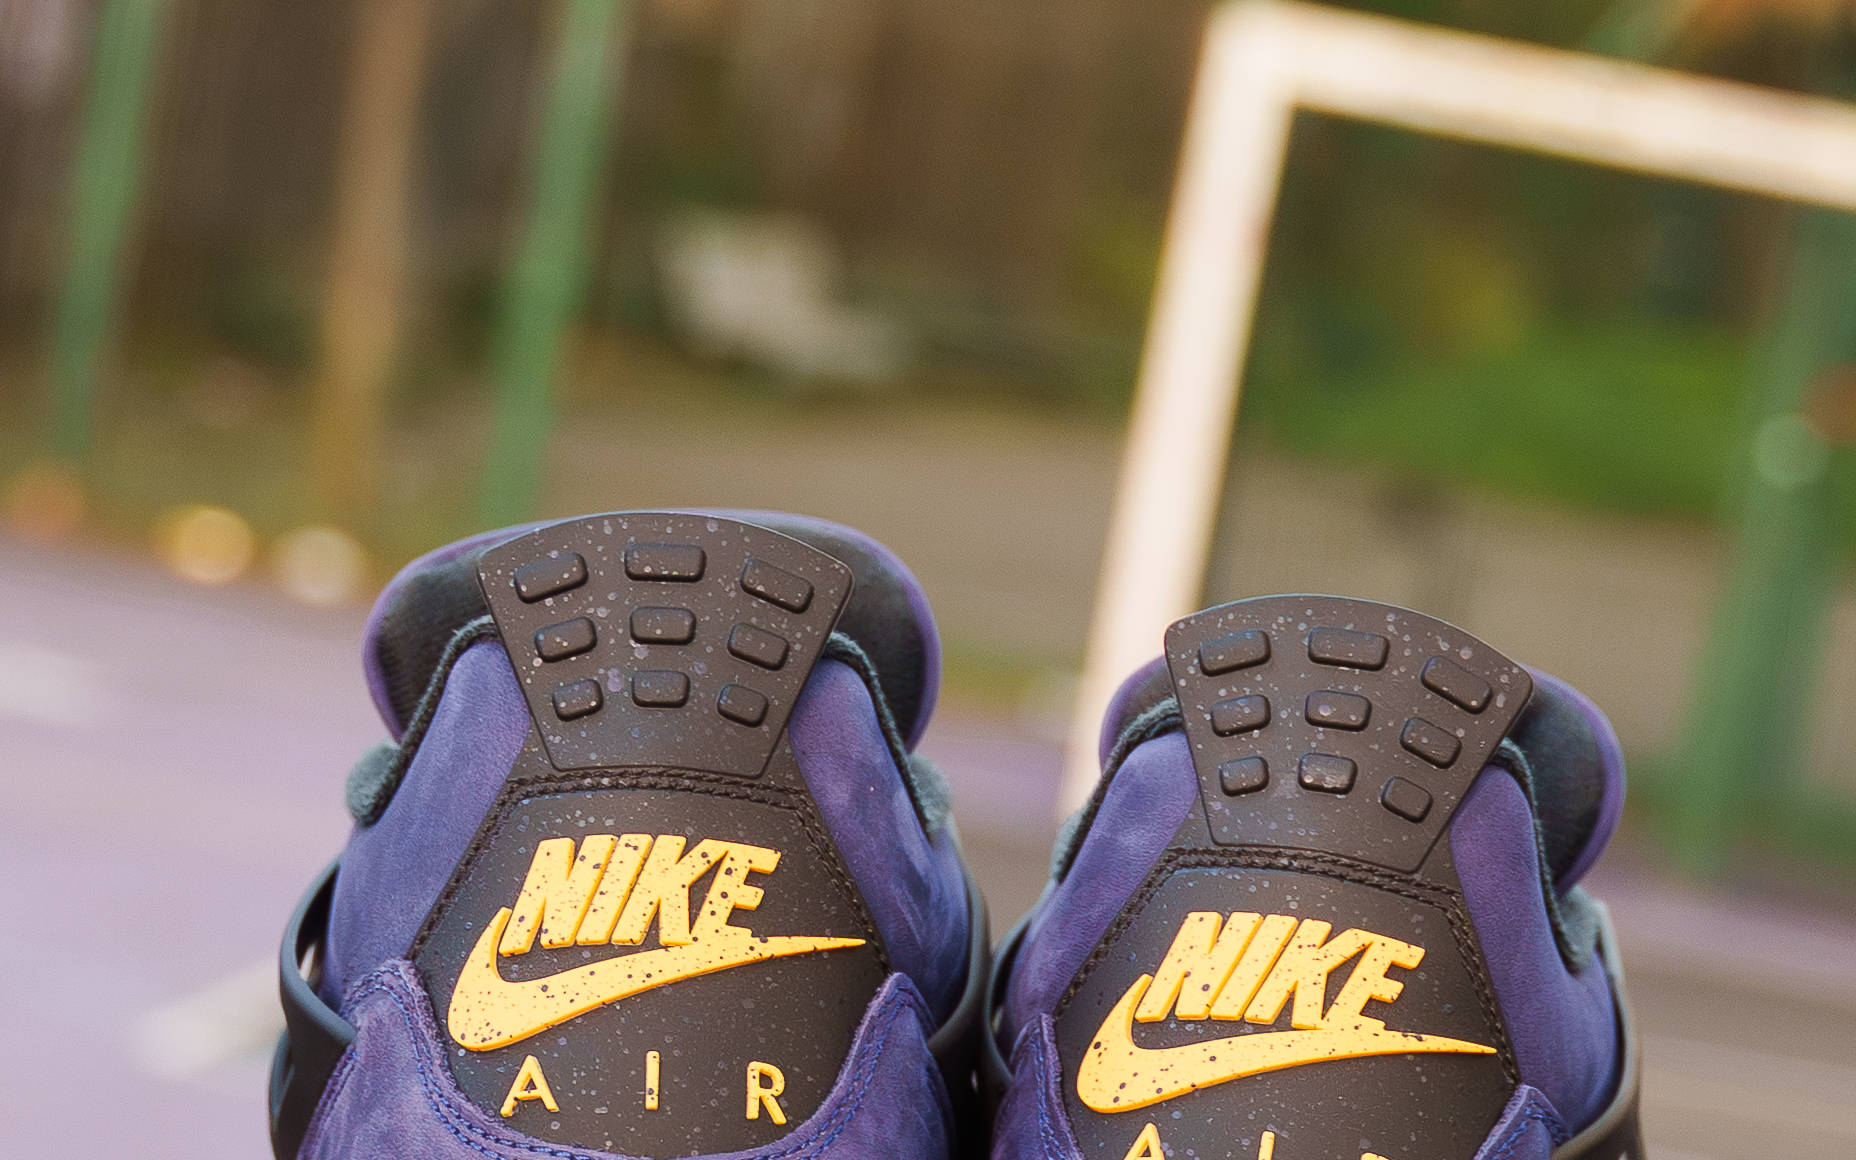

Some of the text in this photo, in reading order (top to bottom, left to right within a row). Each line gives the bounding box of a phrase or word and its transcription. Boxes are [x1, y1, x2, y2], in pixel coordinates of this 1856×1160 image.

[498, 833, 782, 957] NIKE
[1134, 911, 1426, 1031] NIKE
[500, 1050, 787, 1125] AIR
